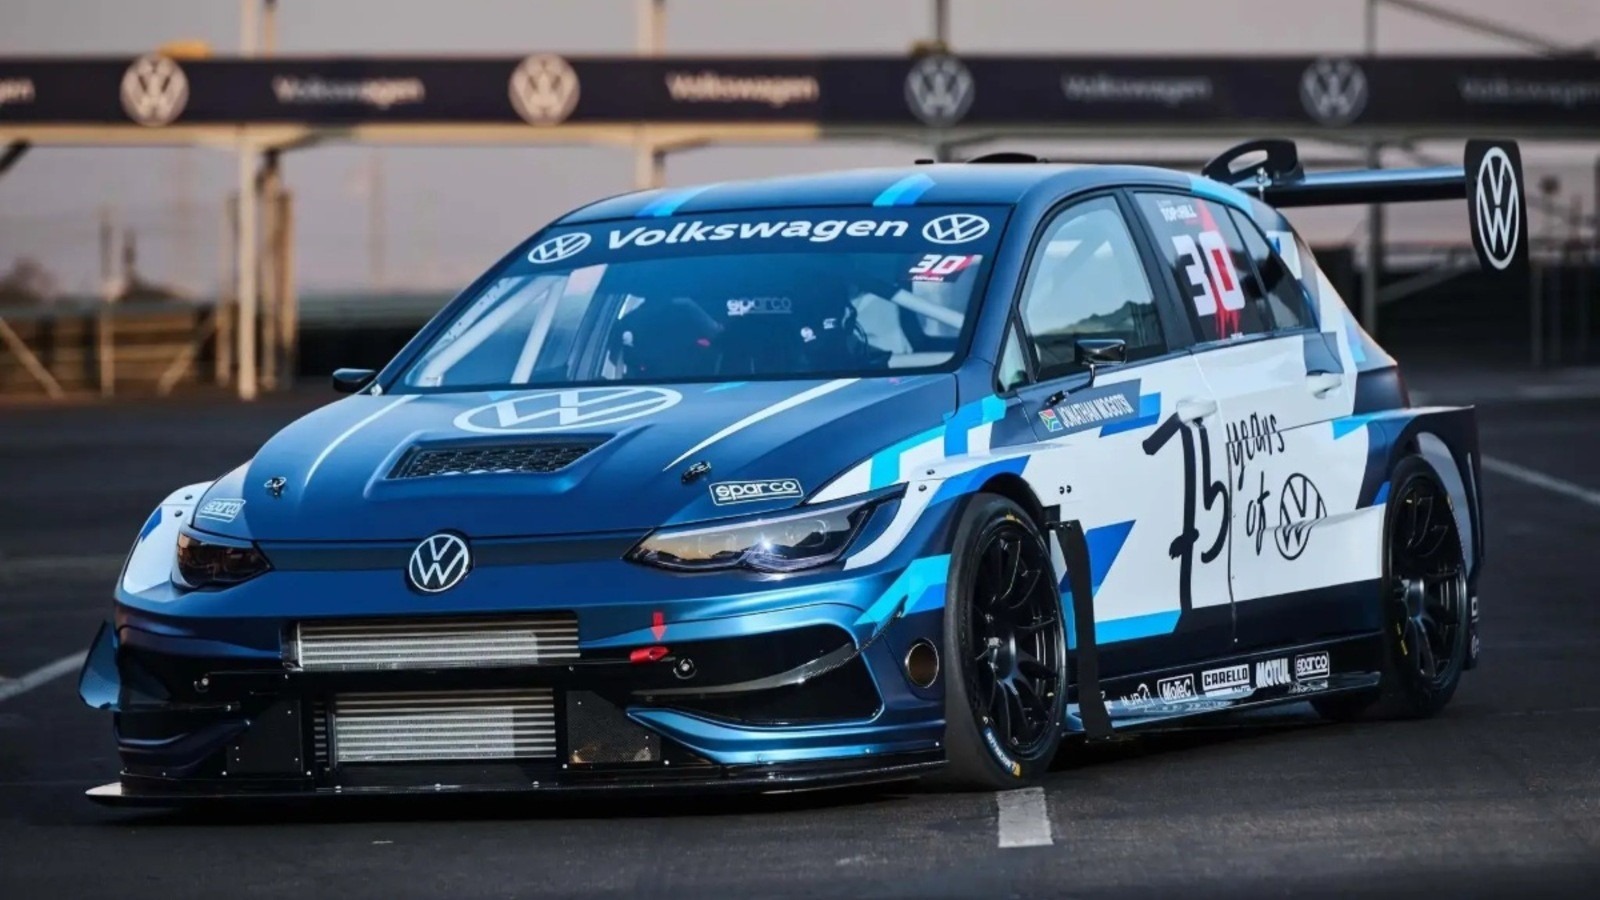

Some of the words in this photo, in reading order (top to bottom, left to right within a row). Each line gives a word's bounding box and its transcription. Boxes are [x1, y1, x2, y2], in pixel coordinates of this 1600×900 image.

[665, 71, 820, 107] Volkswagen
[608, 218, 909, 250] Volkswagen
[908, 254, 967, 274] 30
[1171, 230, 1246, 317] 30
[1226, 412, 1286, 491] years
[715, 480, 800, 501] sparco
[1142, 407, 1230, 612] 75
[1246, 470, 1271, 556] of
[1204, 667, 1248, 687] CARELLO
[1255, 657, 1291, 689] MOTUL
[1295, 655, 1328, 676] sparco
